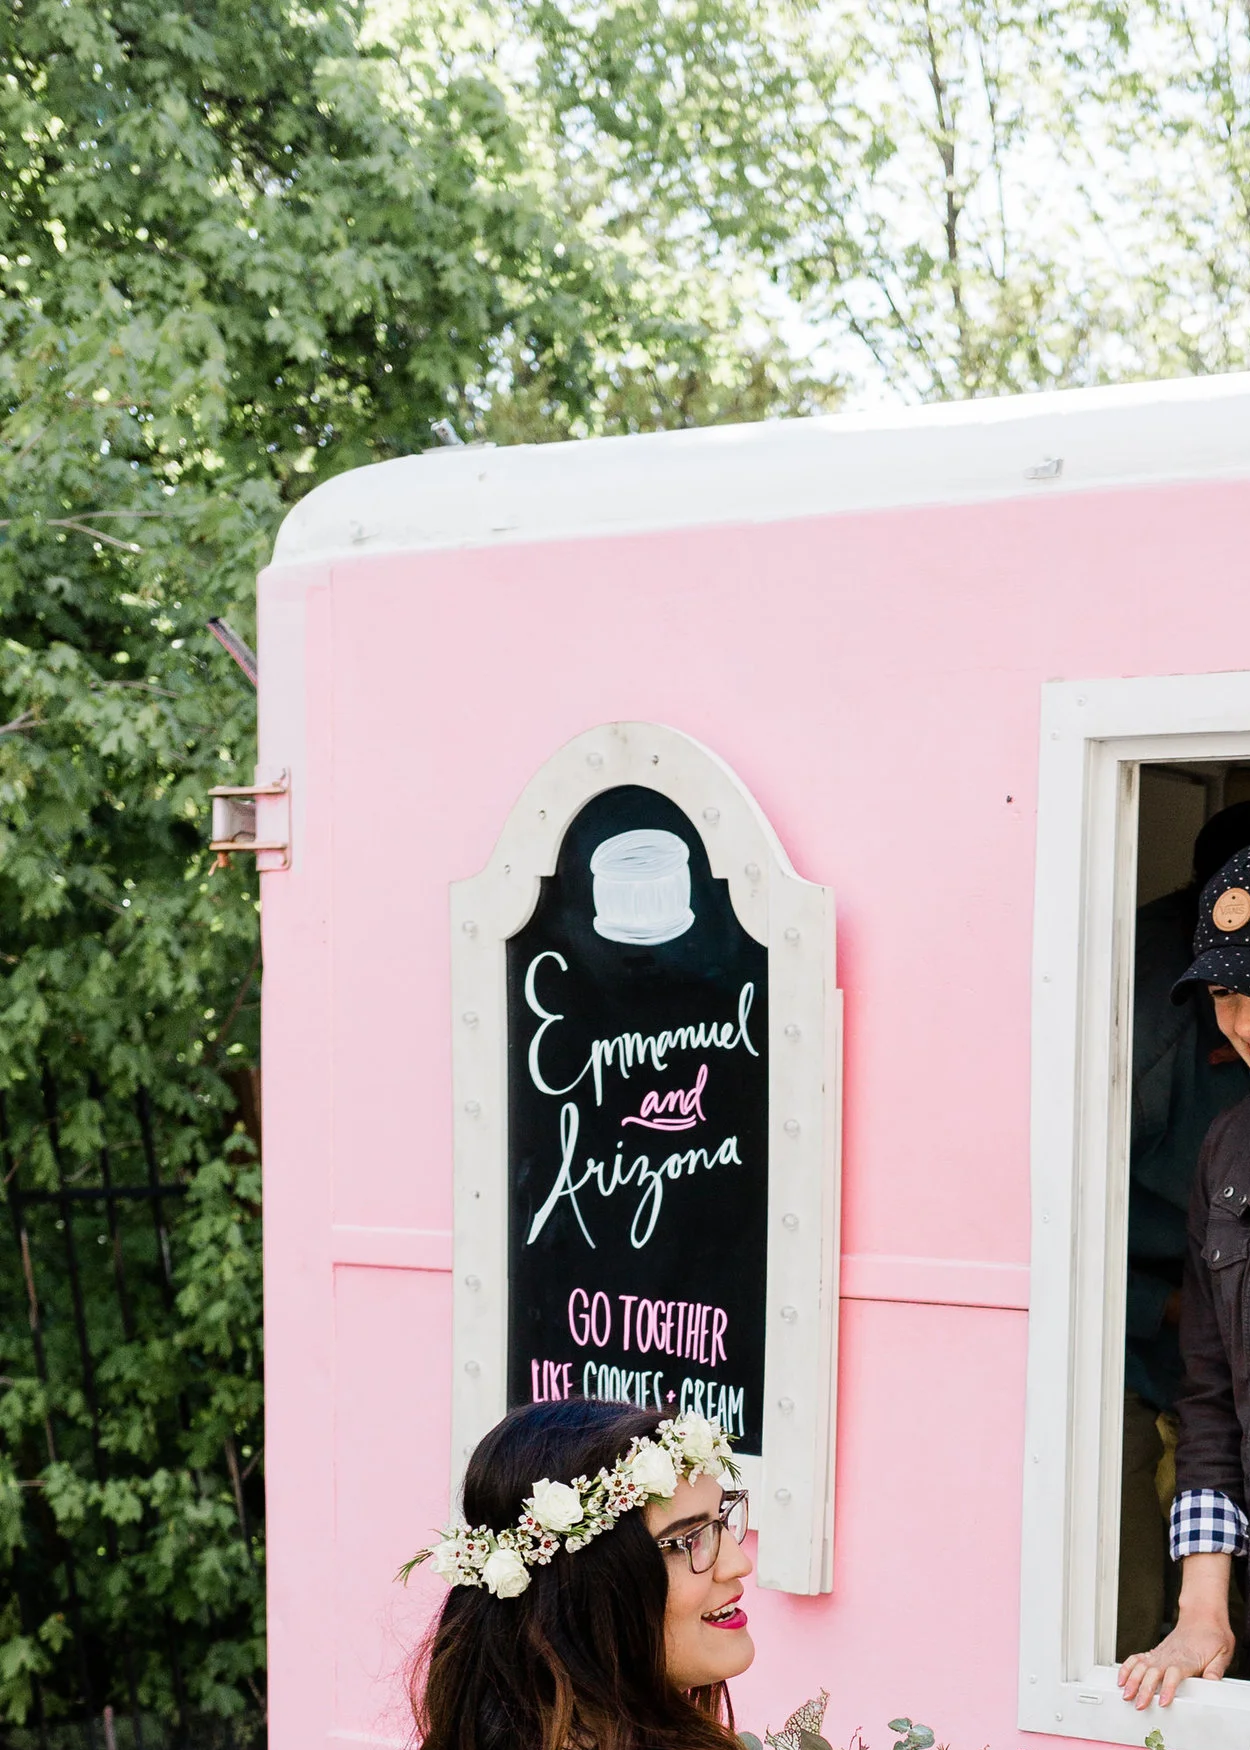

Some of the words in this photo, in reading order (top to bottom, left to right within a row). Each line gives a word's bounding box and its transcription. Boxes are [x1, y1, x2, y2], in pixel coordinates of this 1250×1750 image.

[525, 951, 759, 1106] Emmanuel
[639, 1064, 708, 1122] and
[527, 1102, 742, 1248] Arizona
[568, 1288, 612, 1347] GO
[618, 1295, 728, 1367] TOGETHER
[531, 1358, 573, 1403] LIKE
